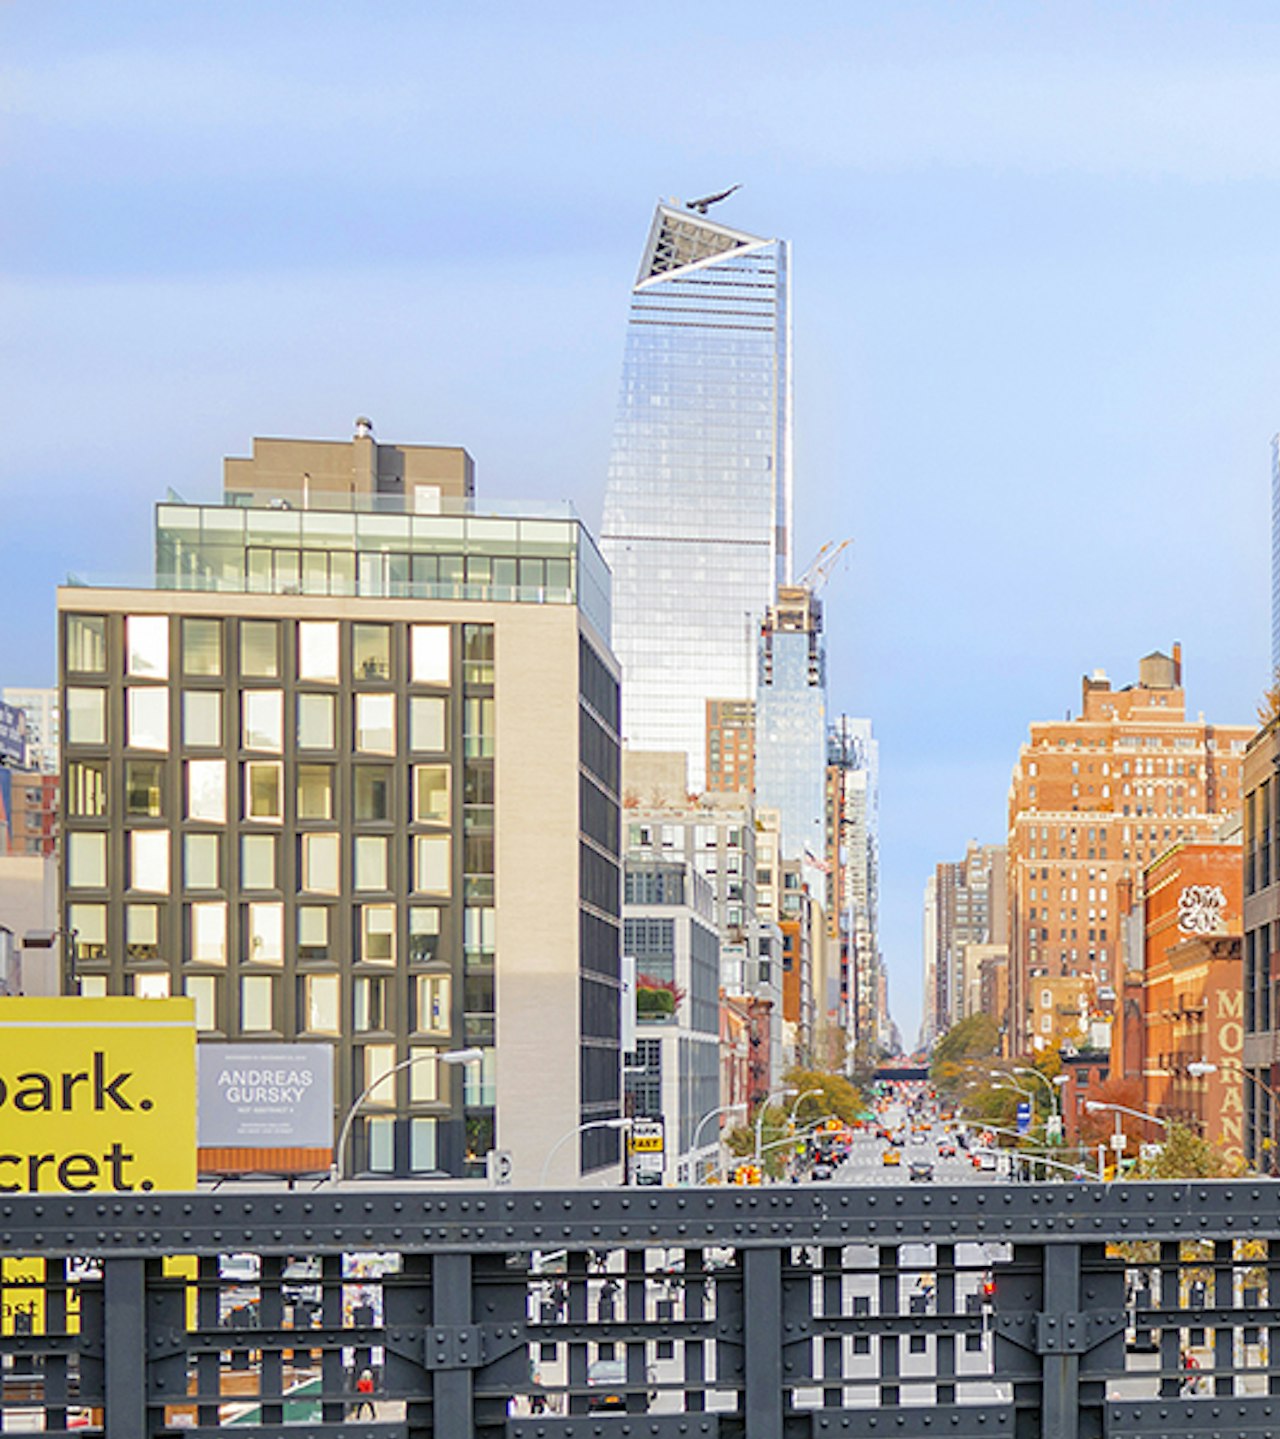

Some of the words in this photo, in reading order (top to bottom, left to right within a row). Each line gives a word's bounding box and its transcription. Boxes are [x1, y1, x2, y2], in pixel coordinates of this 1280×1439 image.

[0, 1052, 153, 1112] ark.
[218, 1069, 313, 1087] ANDREAS
[226, 1086, 305, 1104] GURSKY
